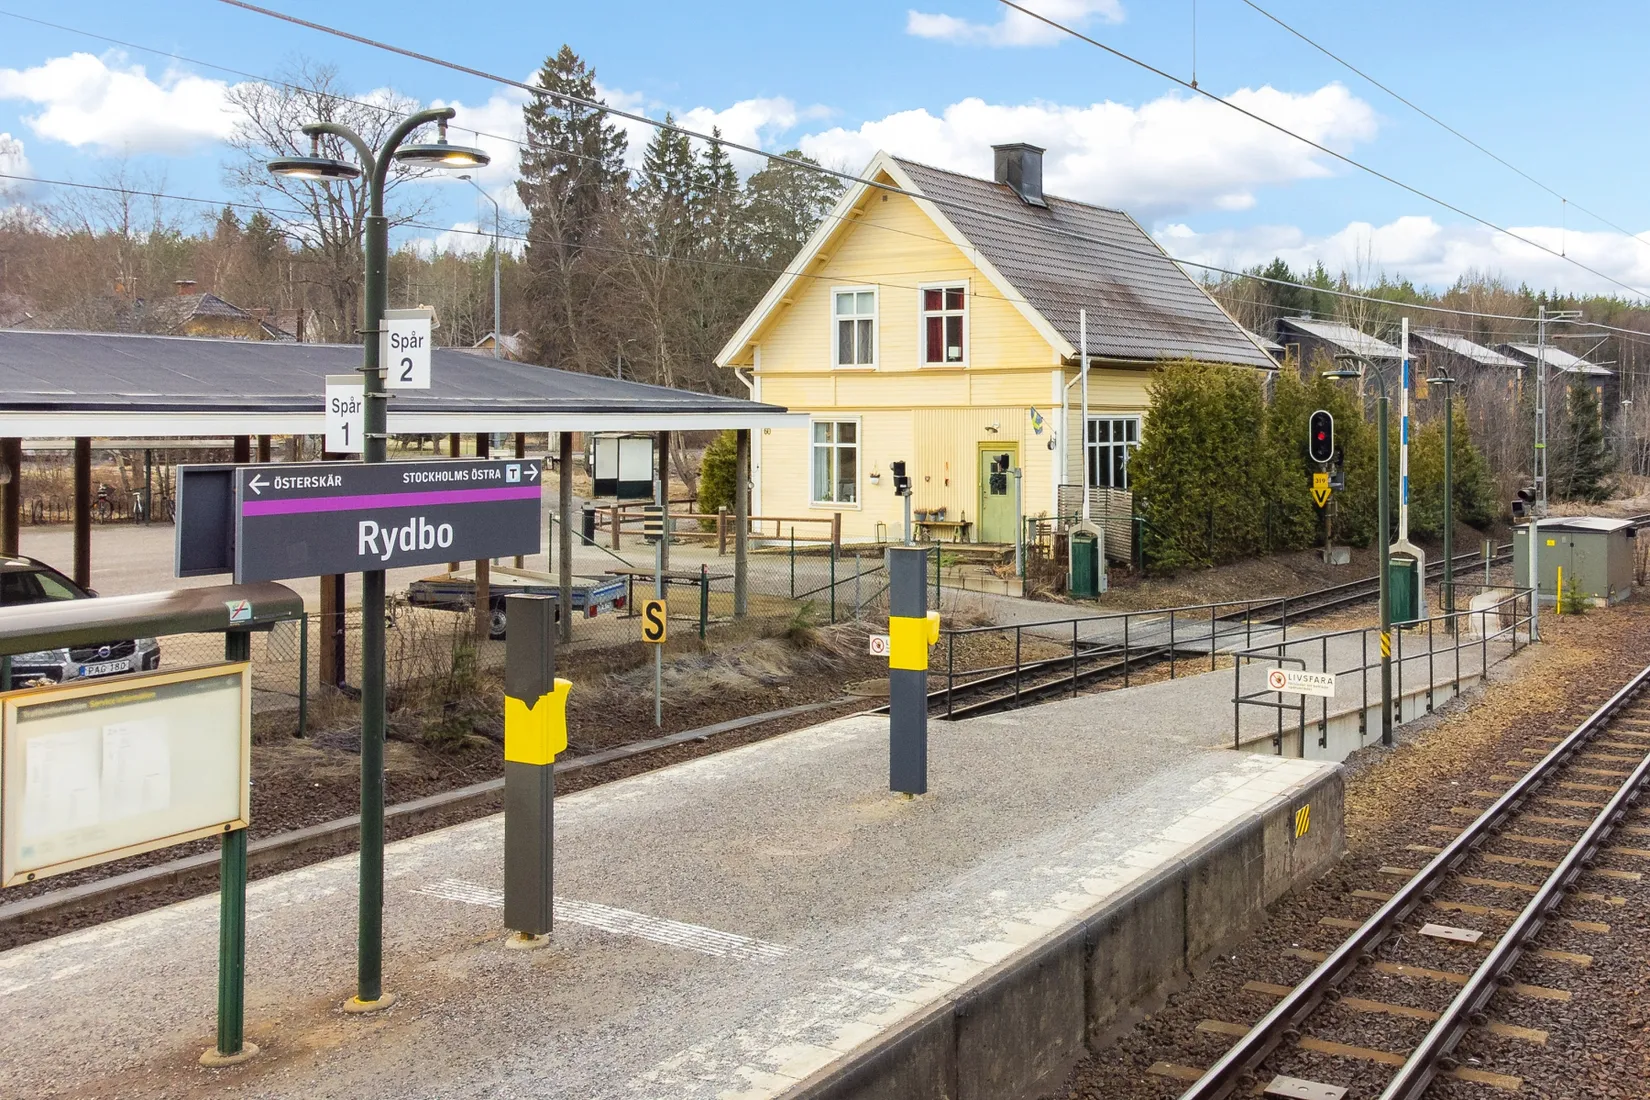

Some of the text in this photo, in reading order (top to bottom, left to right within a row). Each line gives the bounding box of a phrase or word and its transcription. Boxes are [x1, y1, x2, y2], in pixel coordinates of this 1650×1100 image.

[391, 331, 424, 352] Spår
[400, 357, 413, 382] 2
[332, 396, 361, 417] Spår
[341, 422, 349, 446] 1
[274, 474, 342, 490] ÖSTERSKÄR
[402, 468, 517, 484] STOCKHOLMS ÖSTRA T
[1314, 489, 1327, 503] V
[358, 516, 454, 561] Rydbo
[644, 601, 664, 641] S
[1288, 673, 1333, 685] LIVSFARA
